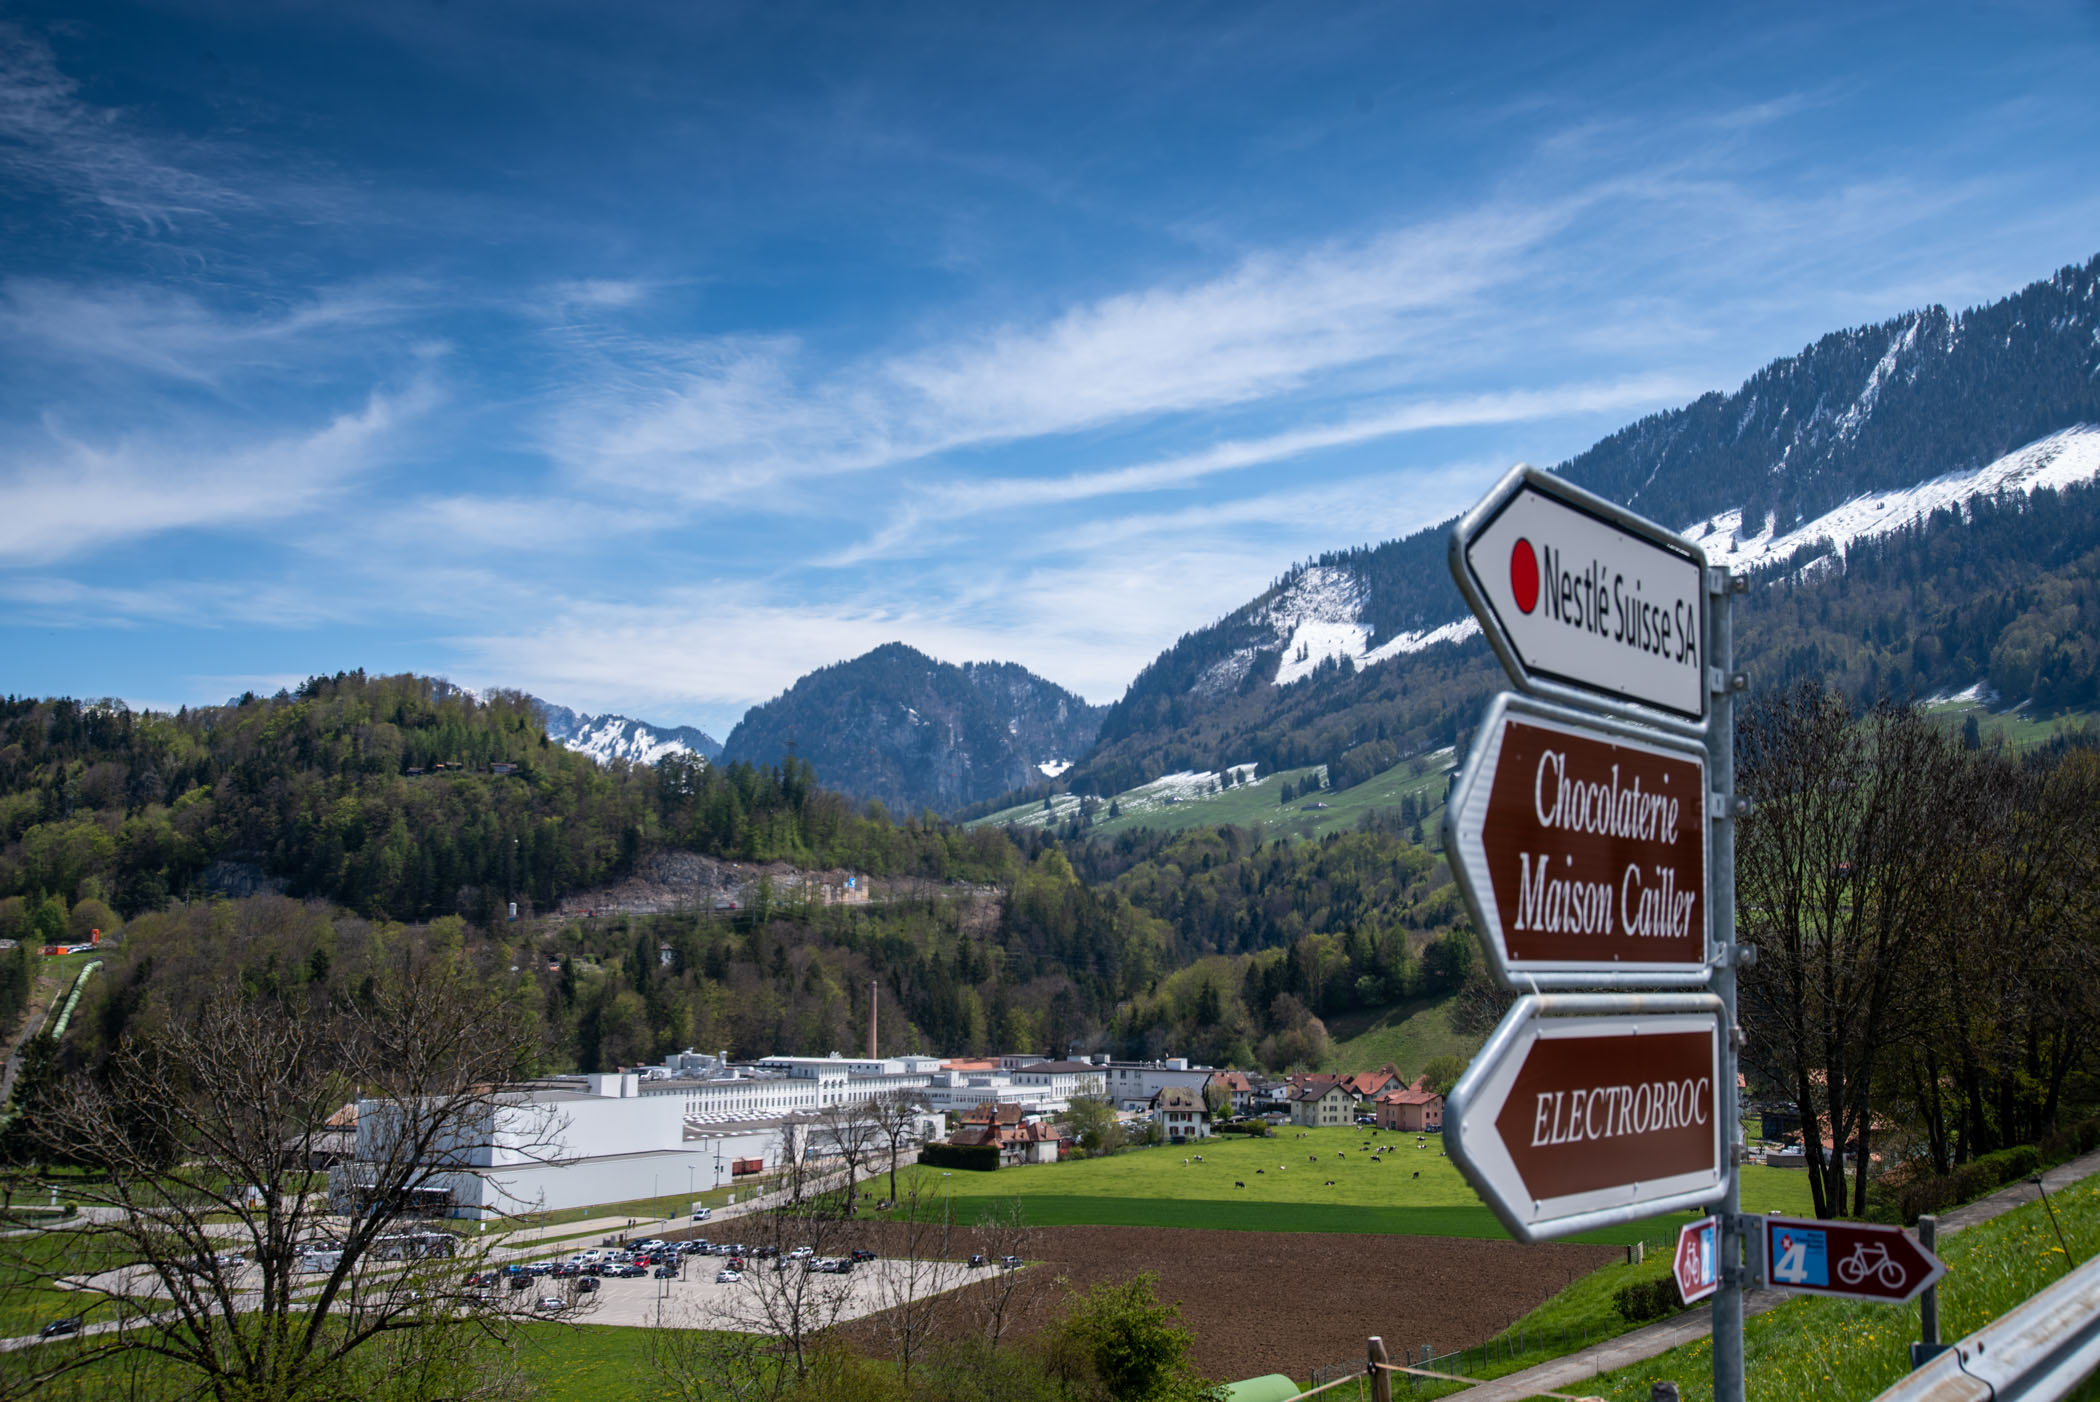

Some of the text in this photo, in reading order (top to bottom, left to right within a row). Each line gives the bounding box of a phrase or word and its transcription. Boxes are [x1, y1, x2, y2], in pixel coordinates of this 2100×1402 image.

[1544, 544, 1697, 668] Nestlé Suisse SA
[1535, 749, 1679, 845] Chocolaterie
[1514, 852, 1696, 938] Maison Cailler
[1530, 1077, 1709, 1147] ELECTROBROC
[1775, 1243, 1808, 1284] 4
